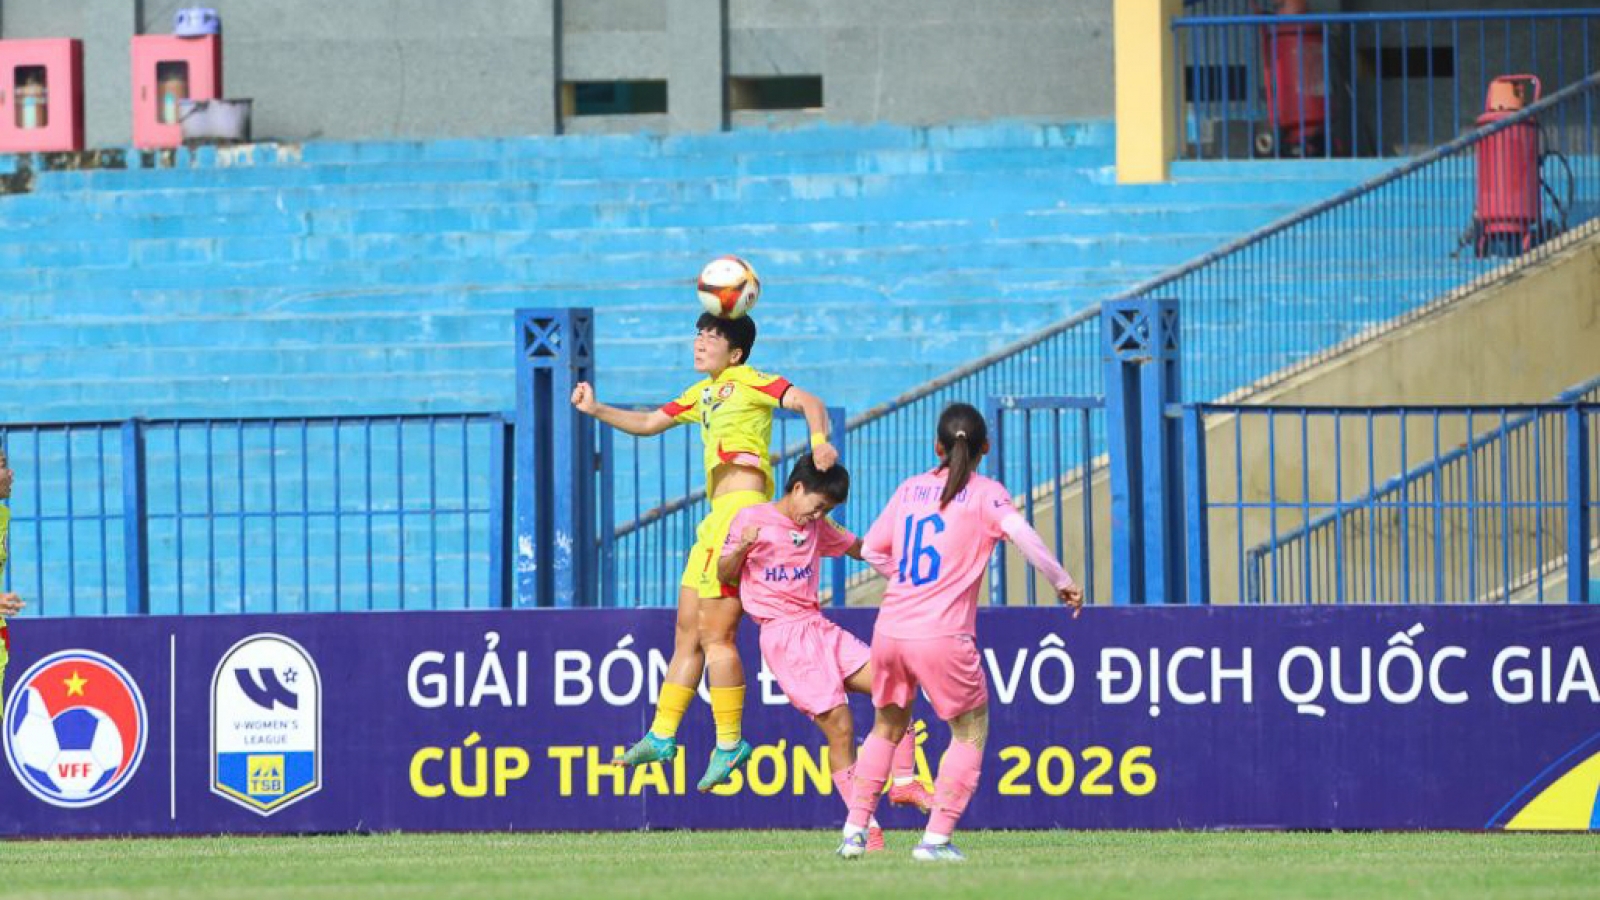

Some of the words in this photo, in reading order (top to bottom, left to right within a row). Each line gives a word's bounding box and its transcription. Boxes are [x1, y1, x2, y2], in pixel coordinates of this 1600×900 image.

[898, 513, 945, 586] 16
[407, 631, 527, 707] GIẢI
[983, 633, 1075, 705] VÔ
[1096, 647, 1252, 717] ĐỊCH
[1278, 622, 1469, 717] QUỐC
[1492, 646, 1600, 704] GIA
[243, 734, 287, 744] LEAGUE
[58, 763, 92, 778] VFF
[409, 731, 530, 797] CÚP
[997, 745, 1157, 797] 2026
[252, 780, 281, 791] TSB
